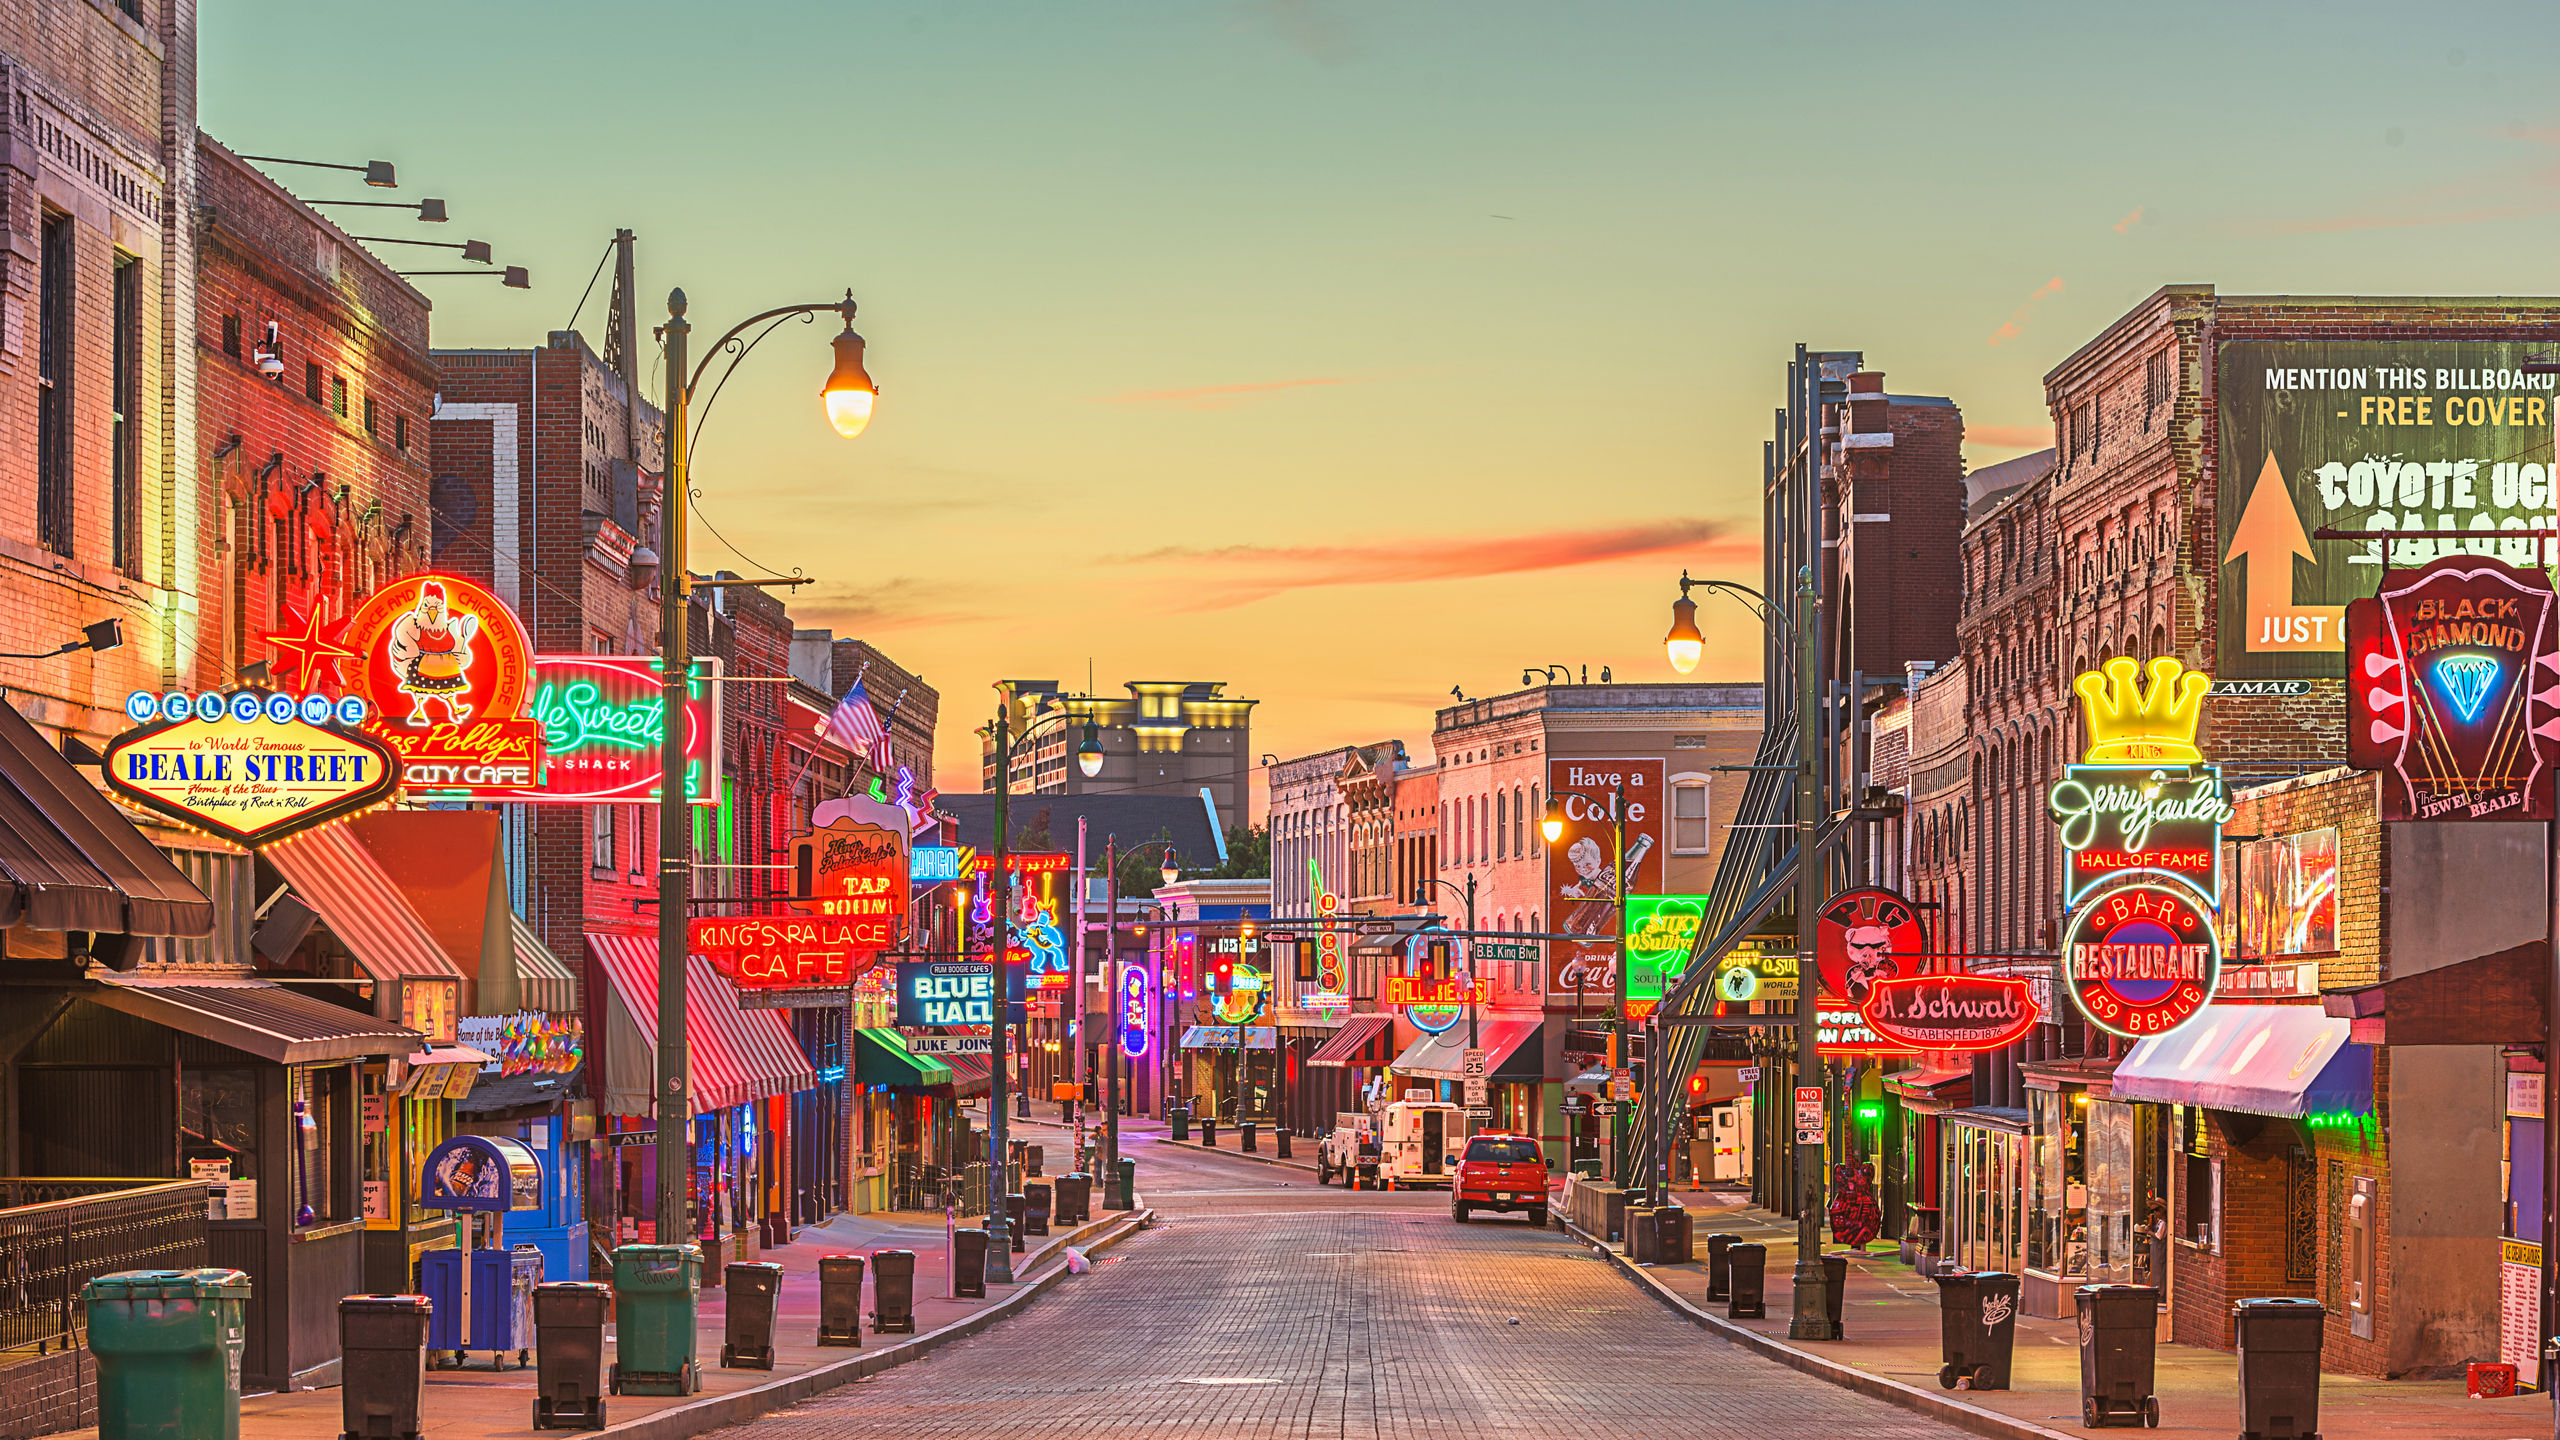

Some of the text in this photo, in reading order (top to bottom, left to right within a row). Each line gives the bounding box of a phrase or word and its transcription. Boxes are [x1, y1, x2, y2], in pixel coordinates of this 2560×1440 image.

[2266, 368, 2556, 390] MENTION THIS BILLBOARD
[2360, 397, 2433, 426] FREE
[2446, 396, 2546, 426] COVER
[2315, 459, 2478, 510] COYOTE
[2366, 510, 2558, 566] SALOON
[387, 589, 416, 611] AND
[2417, 598, 2518, 621] BLACK
[458, 592, 507, 642] CHICKEN
[354, 606, 388, 650] PEACE
[2260, 616, 2328, 644] JUST
[2408, 622, 2526, 656] DIAMOND
[498, 645, 516, 706] GREASE
[2209, 682, 2300, 694] LAMAR
[131, 695, 363, 722] WELCOME
[189, 737, 305, 751] to World Famous
[2128, 745, 2162, 759] KING
[128, 753, 368, 783] BEALE STREET
[464, 766, 530, 784] CAFE
[565, 759, 631, 771] SHACK
[1569, 767, 1644, 786] Have a
[188, 783, 283, 796] Home of the Blues
[2416, 791, 2437, 805] The
[2474, 789, 2485, 803] of
[183, 796, 236, 811] Birthplace
[240, 797, 248, 811] of
[2051, 769, 2236, 853] Jerry Lawler
[2421, 791, 2521, 819] JEWEL BEALE
[825, 838, 863, 858] Kings
[819, 854, 861, 875] Palace
[911, 850, 954, 877] CARGO
[2080, 853, 2209, 867] HALL OF FAME
[843, 877, 890, 896] TAP
[823, 898, 893, 916] ROOM
[1824, 897, 1912, 929] PIG
[2111, 893, 2175, 922] BAR
[1645, 913, 1701, 933] SILKY
[700, 921, 776, 946] KING'S
[1627, 930, 1695, 950] O'Sulliva
[1519, 948, 1539, 961] Blvd.
[1585, 954, 1611, 962] DRIN
[1722, 951, 1799, 975] SILKY O'SUL
[2074, 944, 2209, 980] RESTAURANT
[742, 952, 845, 978] CAFE
[934, 964, 990, 973] RUM BOOGIE CAFE'S
[914, 977, 994, 999] BLUE
[1634, 975, 1668, 984] SOUT
[1763, 981, 1793, 989] WORLD
[1872, 984, 2026, 1020] A. Schwab
[2086, 987, 2201, 1031] 159 BEALE
[925, 1002, 993, 1023] HALL
[458, 1028, 474, 1041] Home
[476, 1027, 484, 1044] of
[484, 1028, 494, 1041] the
[1817, 1027, 1883, 1043] AN ATTI
[1900, 1027, 2003, 1040] ESTABLISHED 1876
[914, 1039, 948, 1051] JUKE
[1465, 1063, 1484, 1073] 25
[1801, 1090, 1818, 1099] NO
[621, 1134, 658, 1147] ATM
[364, 1205, 376, 1214] nly
[2512, 1246, 2523, 1262] CREAM
[2523, 1247, 2541, 1265] FLAVOURS
